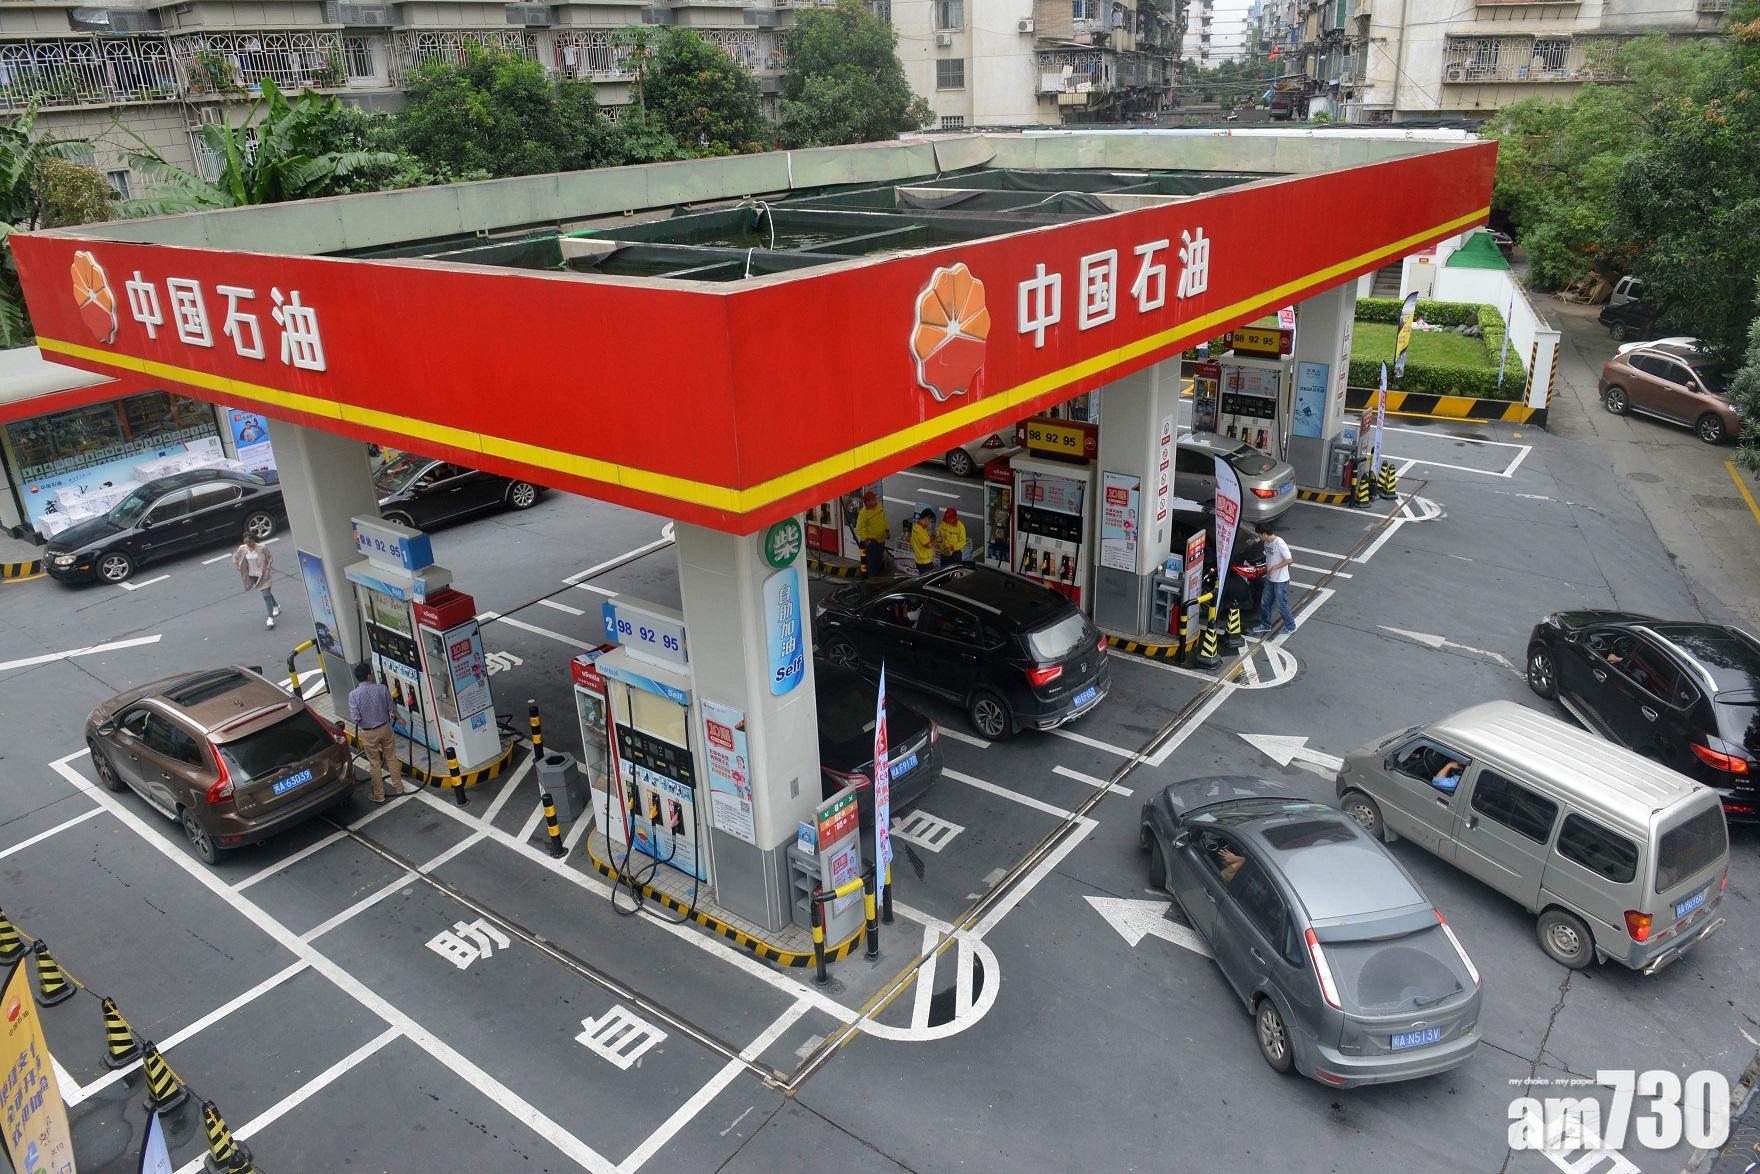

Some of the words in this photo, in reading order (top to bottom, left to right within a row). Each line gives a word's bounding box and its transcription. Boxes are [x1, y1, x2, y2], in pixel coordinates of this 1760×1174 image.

[1018, 227, 1209, 348] 中国石油
[126, 271, 327, 372] 中国石油
[1235, 335, 1245, 343] 98
[1029, 431, 1041, 440] 98
[1046, 433, 1058, 443] 92
[1063, 436, 1076, 446] 95
[375, 540, 386, 552] 92
[390, 544, 401, 557] 95
[773, 525, 799, 561] 柴
[606, 616, 614, 632] 2
[618, 619, 633, 636] 98
[640, 626, 656, 643] 92
[663, 634, 679, 651] 95
[779, 584, 796, 657] 自助加油
[776, 655, 803, 682] Self
[667, 688, 683, 700] Self
[425, 918, 510, 970] 助
[575, 1004, 668, 1070] 自
